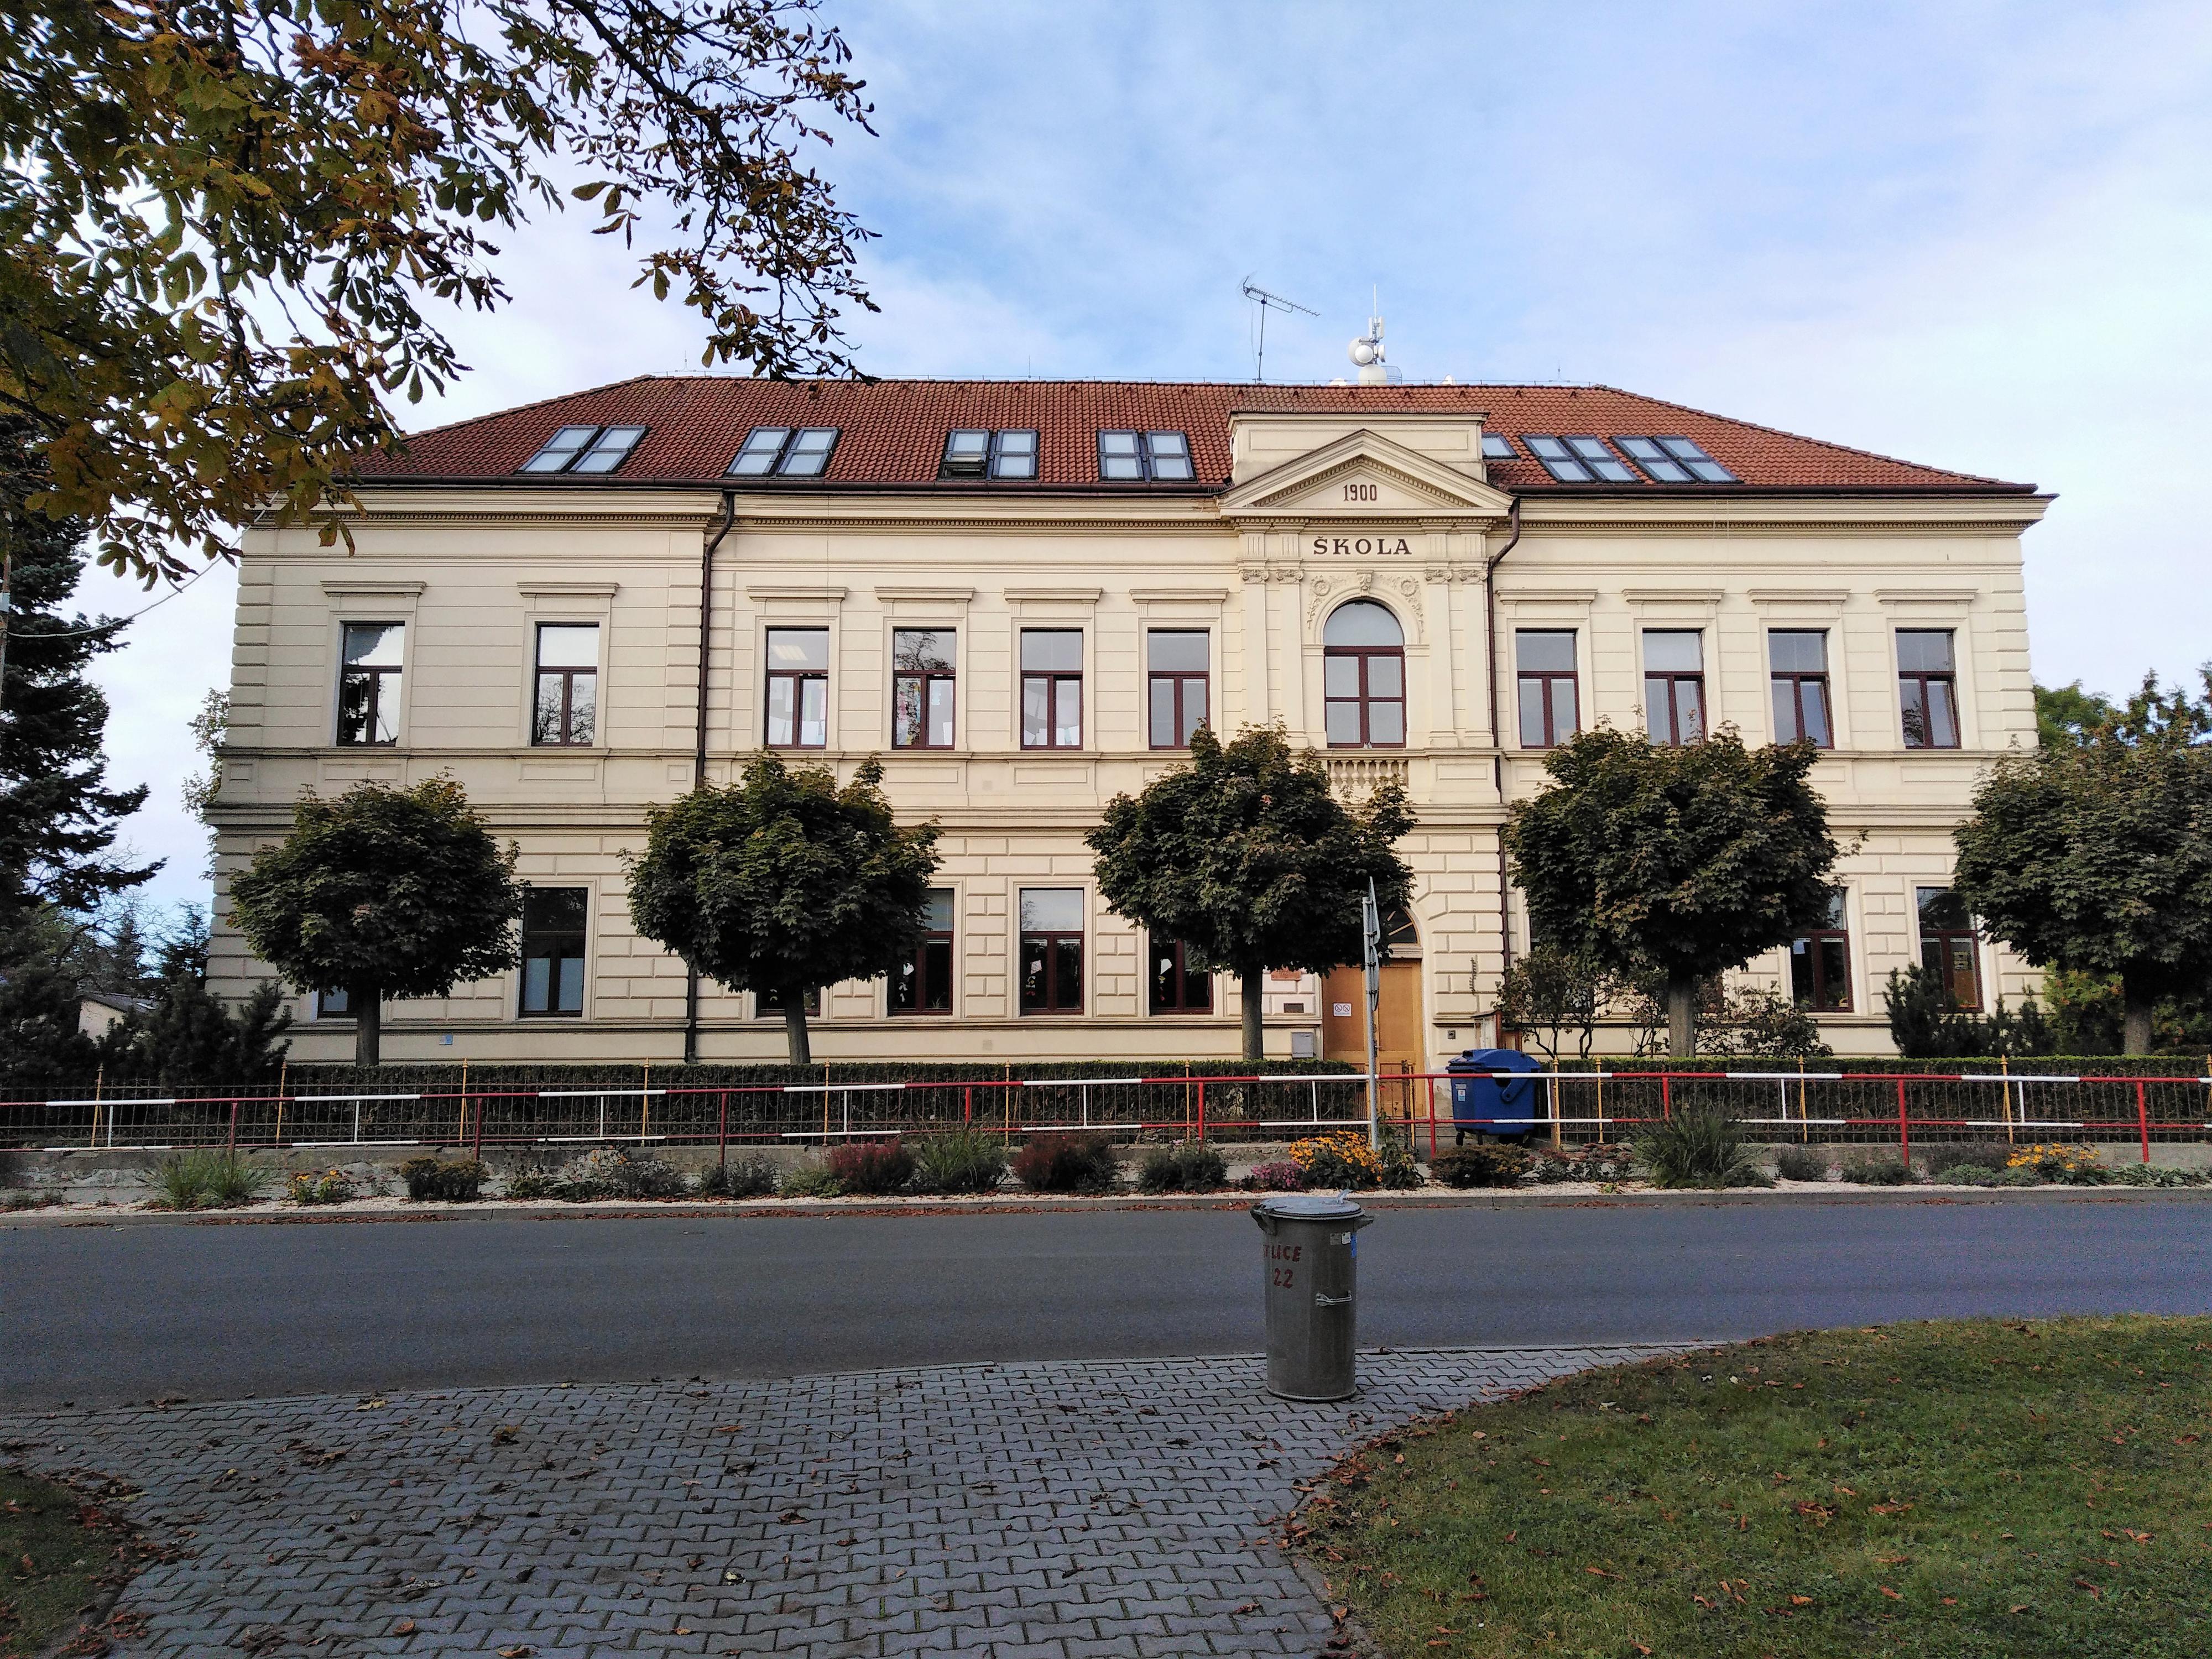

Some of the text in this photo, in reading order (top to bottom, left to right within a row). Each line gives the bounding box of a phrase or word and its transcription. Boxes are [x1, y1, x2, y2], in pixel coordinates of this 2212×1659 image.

[1343, 484, 1377, 502] 1900
[1313, 536, 1412, 555] ŠKOLA
[1274, 1268, 1293, 1288] 22
